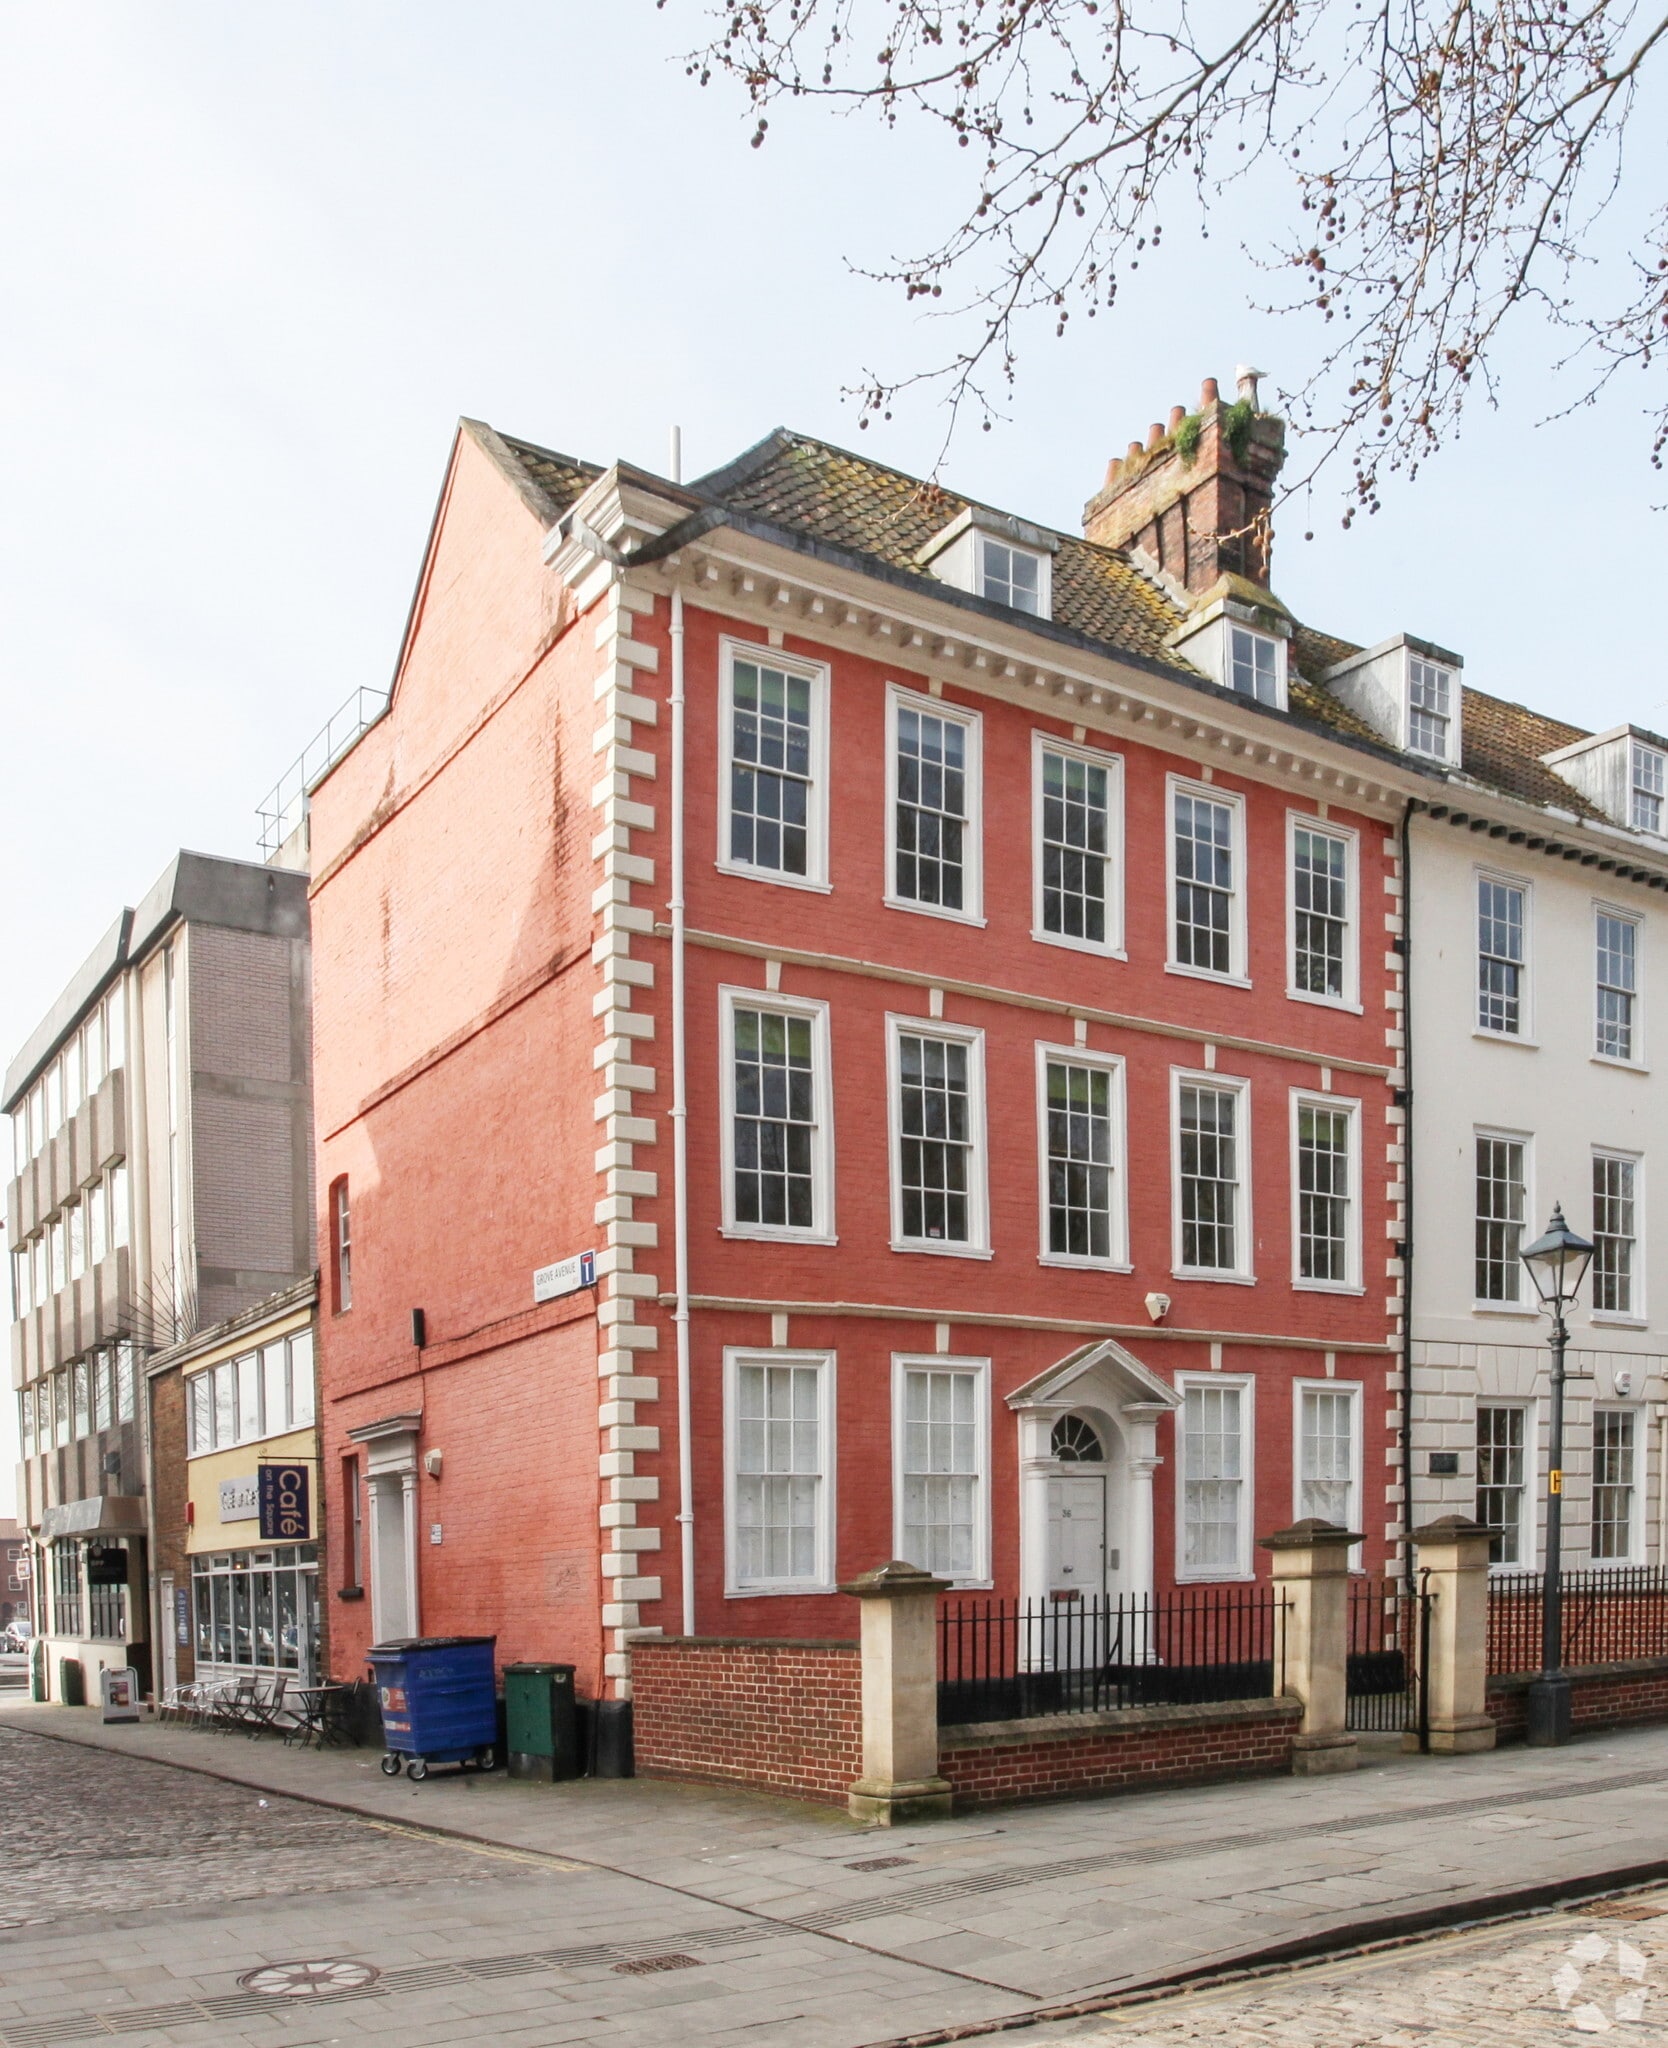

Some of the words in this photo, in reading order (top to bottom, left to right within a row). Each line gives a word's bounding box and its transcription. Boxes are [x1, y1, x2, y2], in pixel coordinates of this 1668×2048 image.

[536, 1270, 554, 1286] GROVE
[554, 1262, 576, 1280] AVENUE
[266, 1469, 273, 1481] on
[266, 1485, 274, 1500] the
[279, 1470, 304, 1535] Café
[266, 1503, 274, 1535] Square
